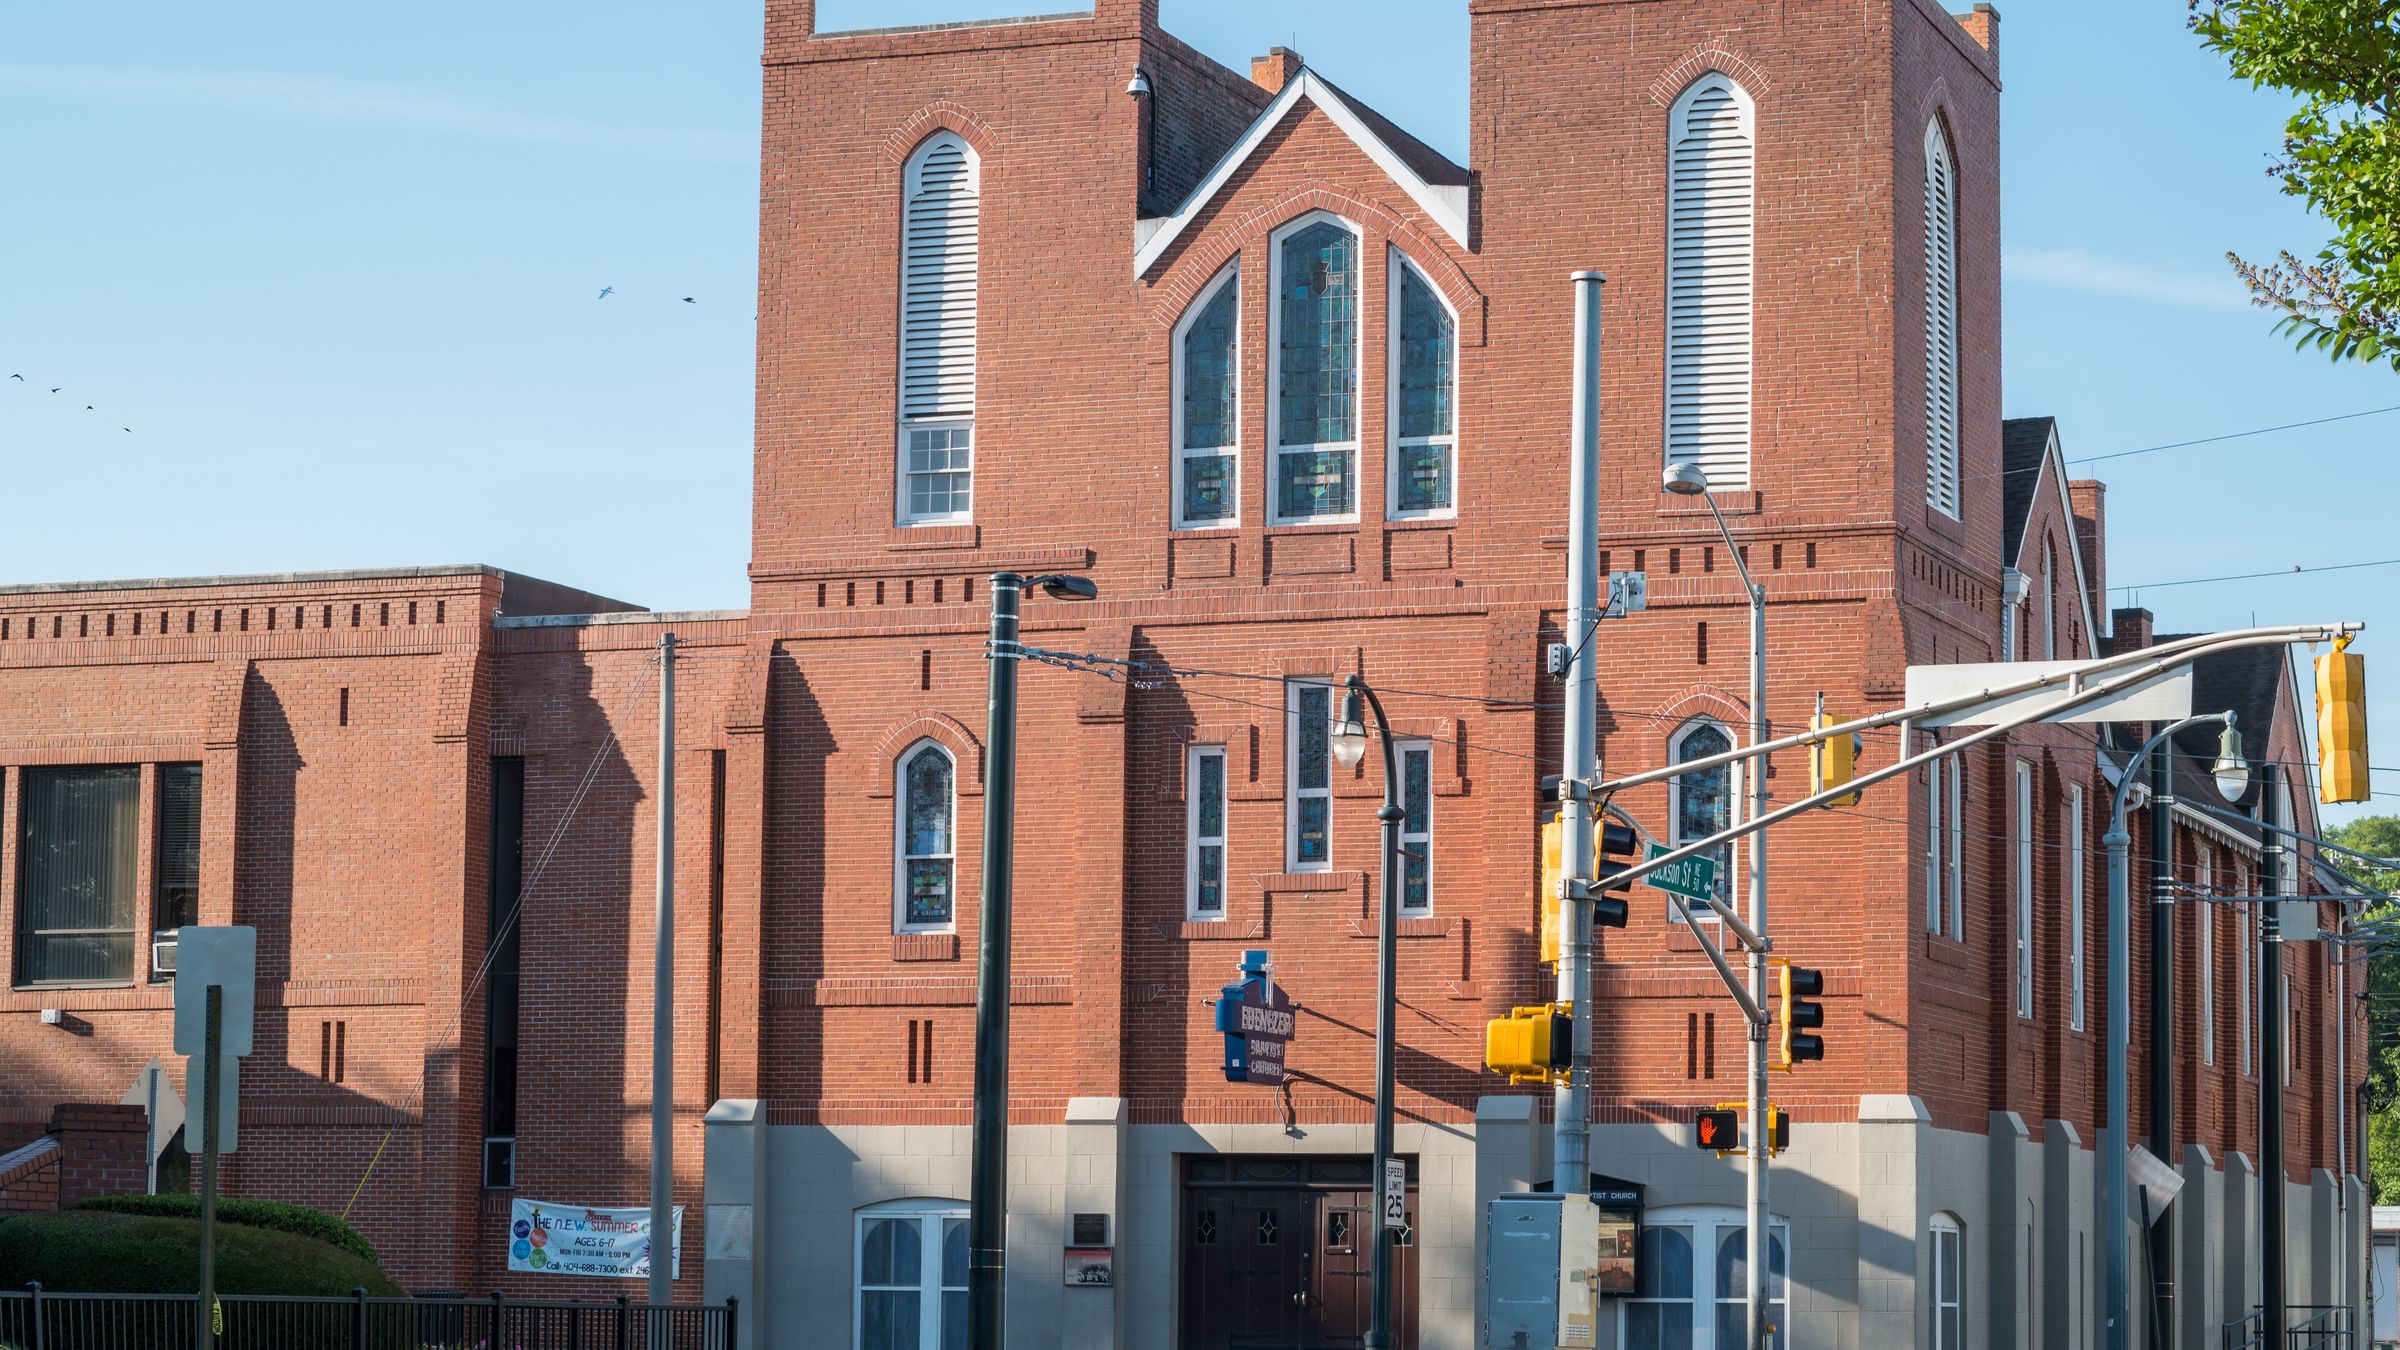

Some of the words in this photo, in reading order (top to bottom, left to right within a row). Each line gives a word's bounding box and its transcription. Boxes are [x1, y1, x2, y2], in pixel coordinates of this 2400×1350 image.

[1682, 860, 1692, 888] St
[1692, 877, 1700, 891] 50
[1242, 1005, 1294, 1036] EBENEZER
[1387, 1166, 1403, 1178] SPEED
[1389, 1181, 1402, 1191] LIMIT
[1610, 1191, 1637, 1199] CHURCH
[1387, 1195, 1403, 1219] 25
[532, 1209, 552, 1230] THE
[575, 1236, 597, 1247] AGES
[598, 1238, 615, 1248] 6-17
[559, 1248, 582, 1256] MON-FRI
[583, 1249, 595, 1257] 7:30
[563, 1262, 618, 1274] 404-688-7300
